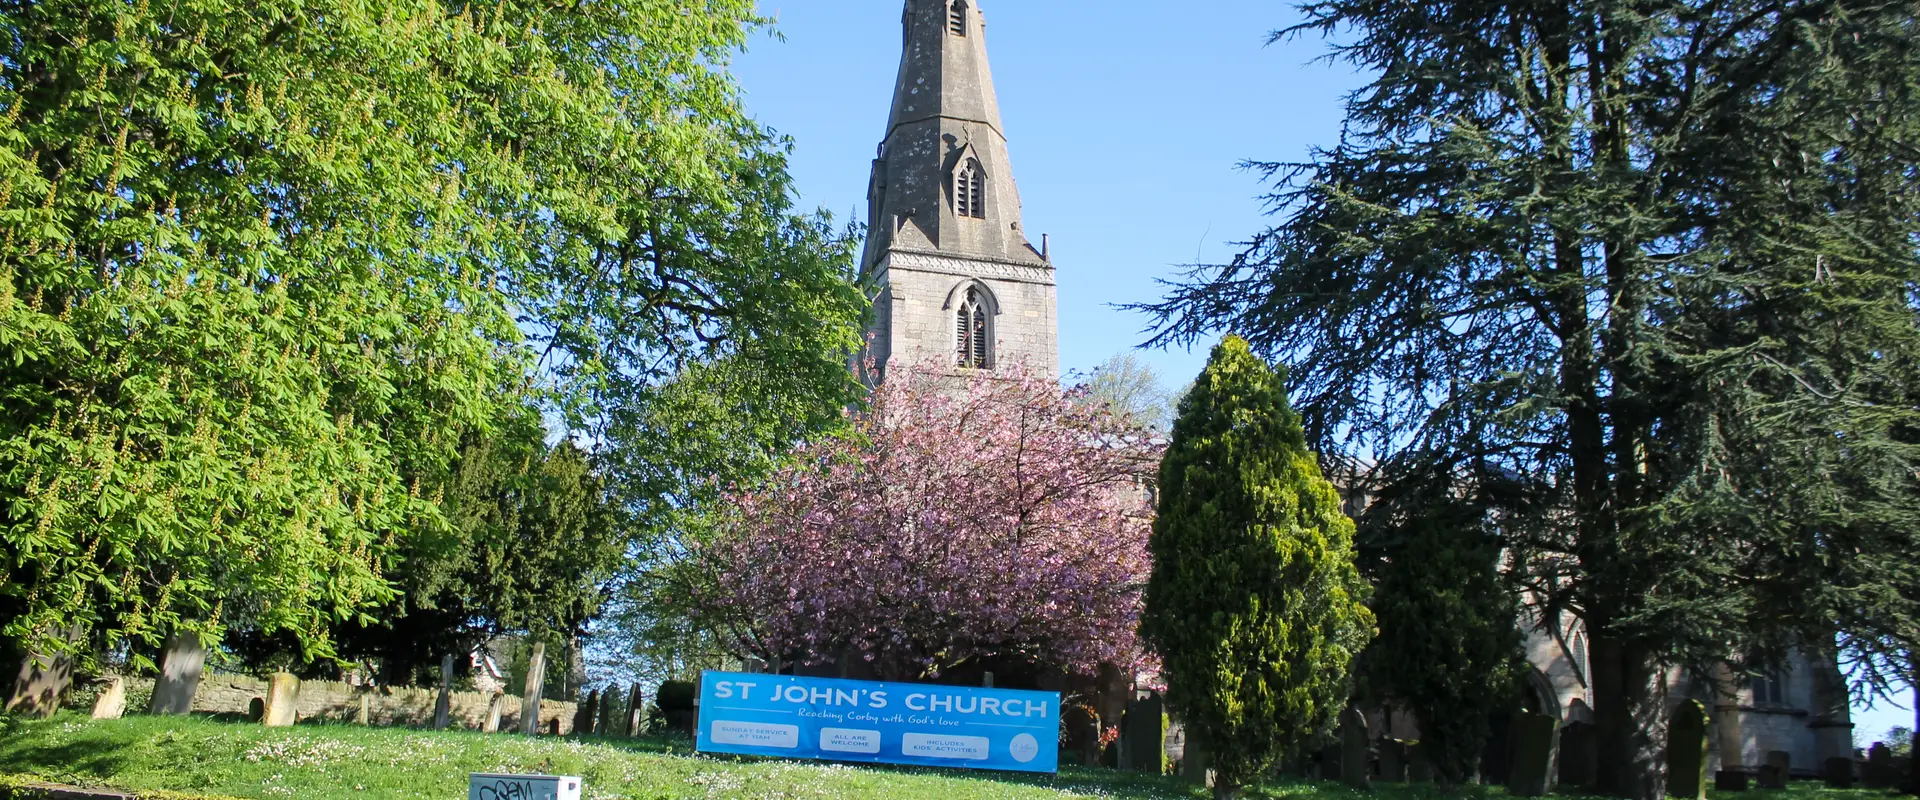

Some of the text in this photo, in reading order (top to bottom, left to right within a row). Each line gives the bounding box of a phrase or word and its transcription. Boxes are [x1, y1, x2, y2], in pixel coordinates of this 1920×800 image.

[714, 681, 1048, 718] ST JOHN'S CHURCH
[797, 707, 960, 727] Reaching Corby with God's love
[721, 726, 788, 736] SUNDAY SERVICE
[830, 739, 870, 748] WELCOME
[926, 739, 965, 747] INCLUDES
[935, 745, 978, 754] ACTIVITIES
